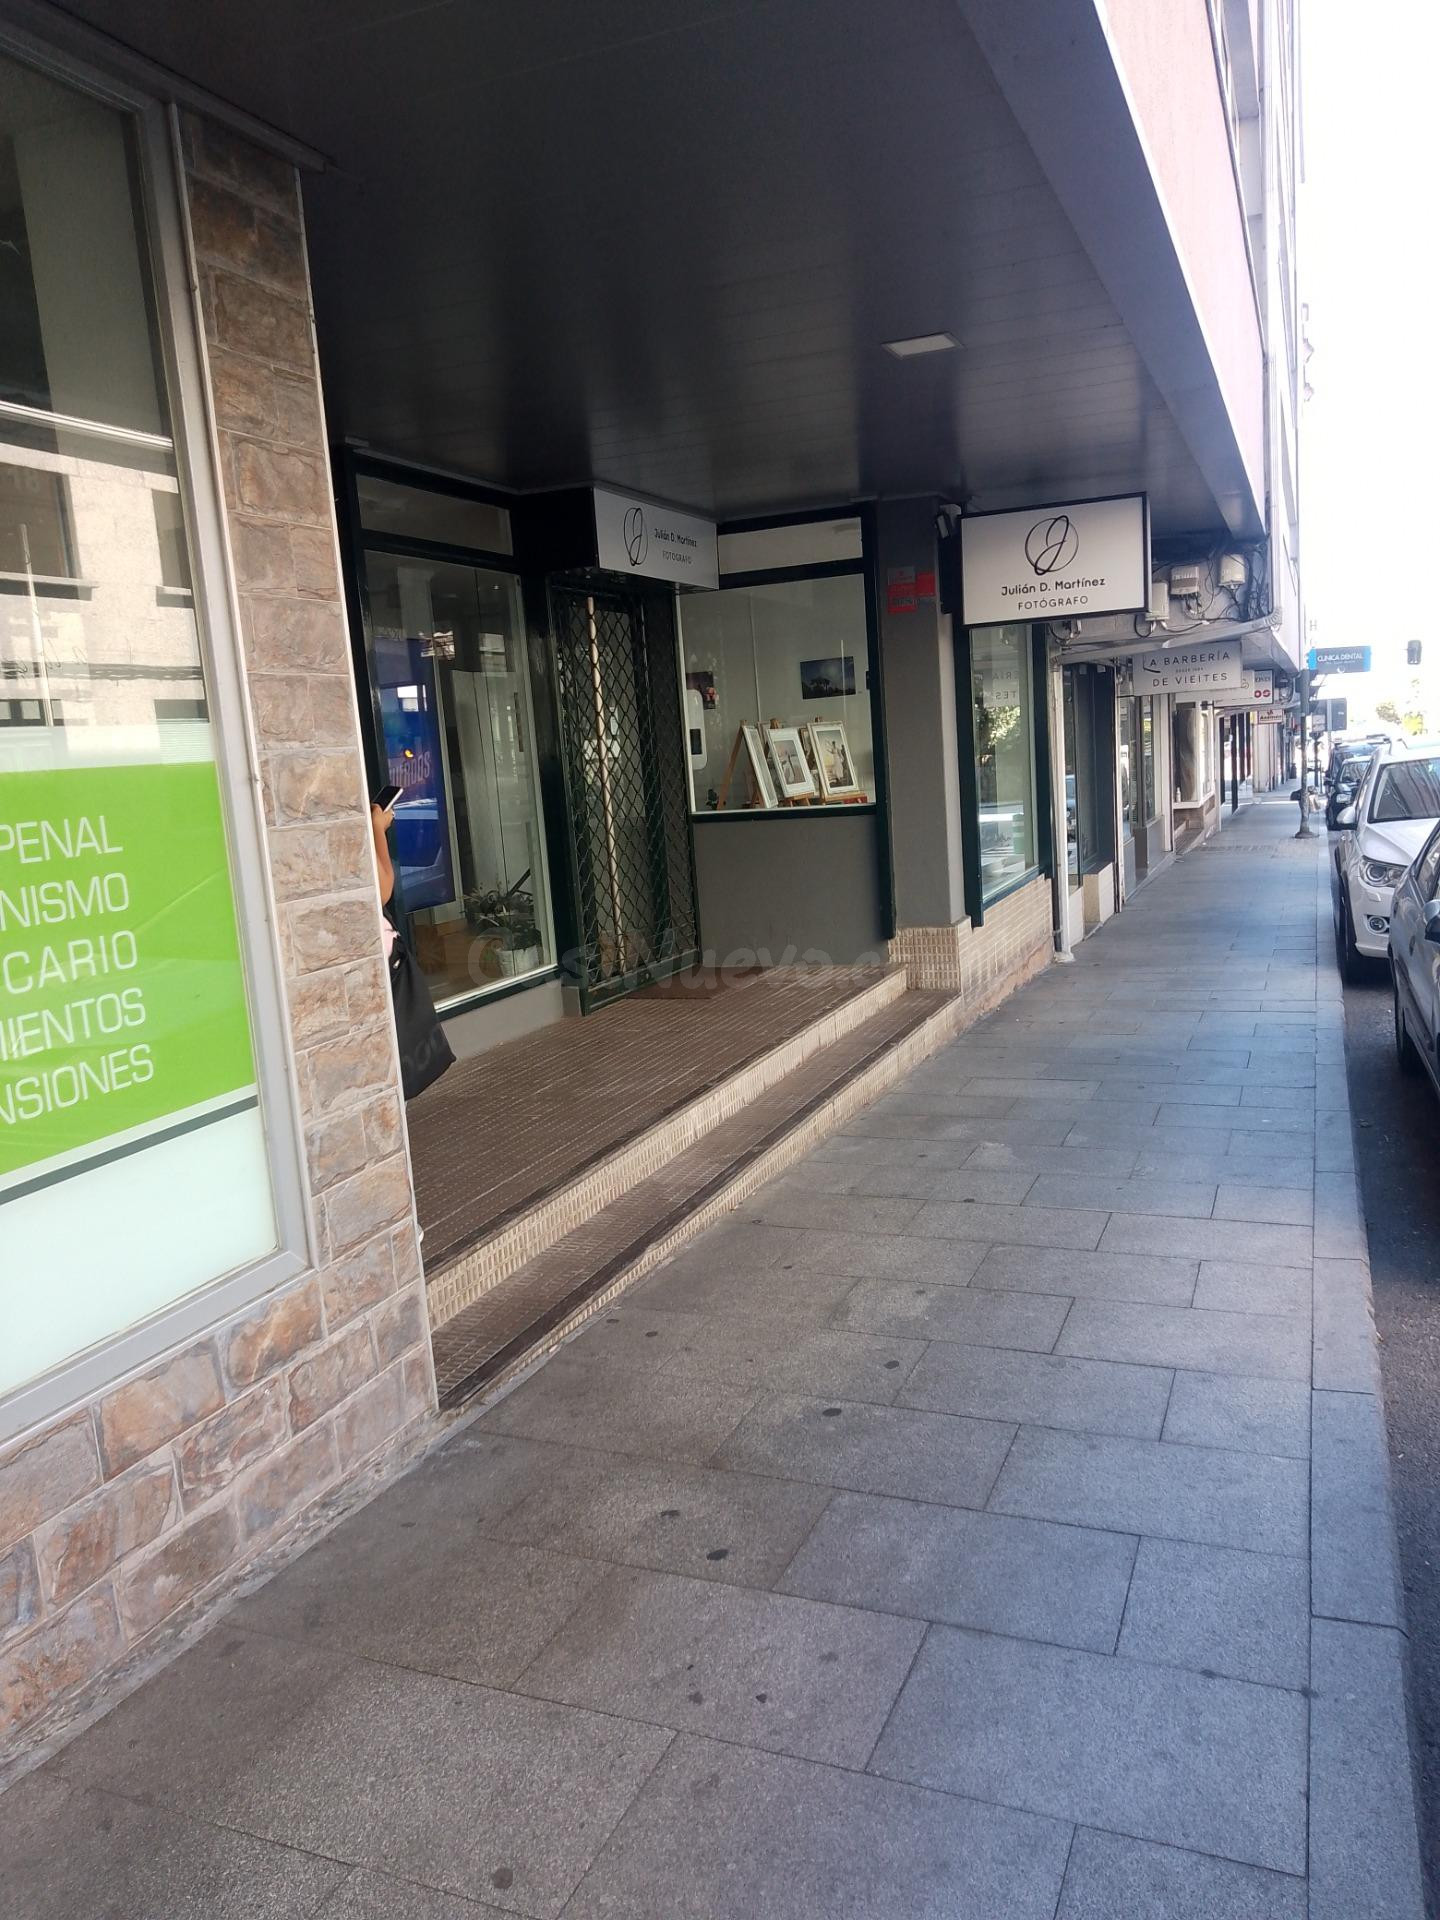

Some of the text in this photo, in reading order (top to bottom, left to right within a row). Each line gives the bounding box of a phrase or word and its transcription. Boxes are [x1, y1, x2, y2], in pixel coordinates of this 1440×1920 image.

[1001, 577, 1106, 596] Julián D. Martínez
[1018, 594, 1089, 611] FOTÓGRAFO
[1164, 650, 1231, 667] BARBERÍA
[1153, 672, 1228, 688] DE VIEITES
[0, 815, 123, 864] PENAL
[0, 872, 129, 932] NISMO
[3, 929, 138, 995] CARIO
[0, 987, 146, 1062] IENTOS
